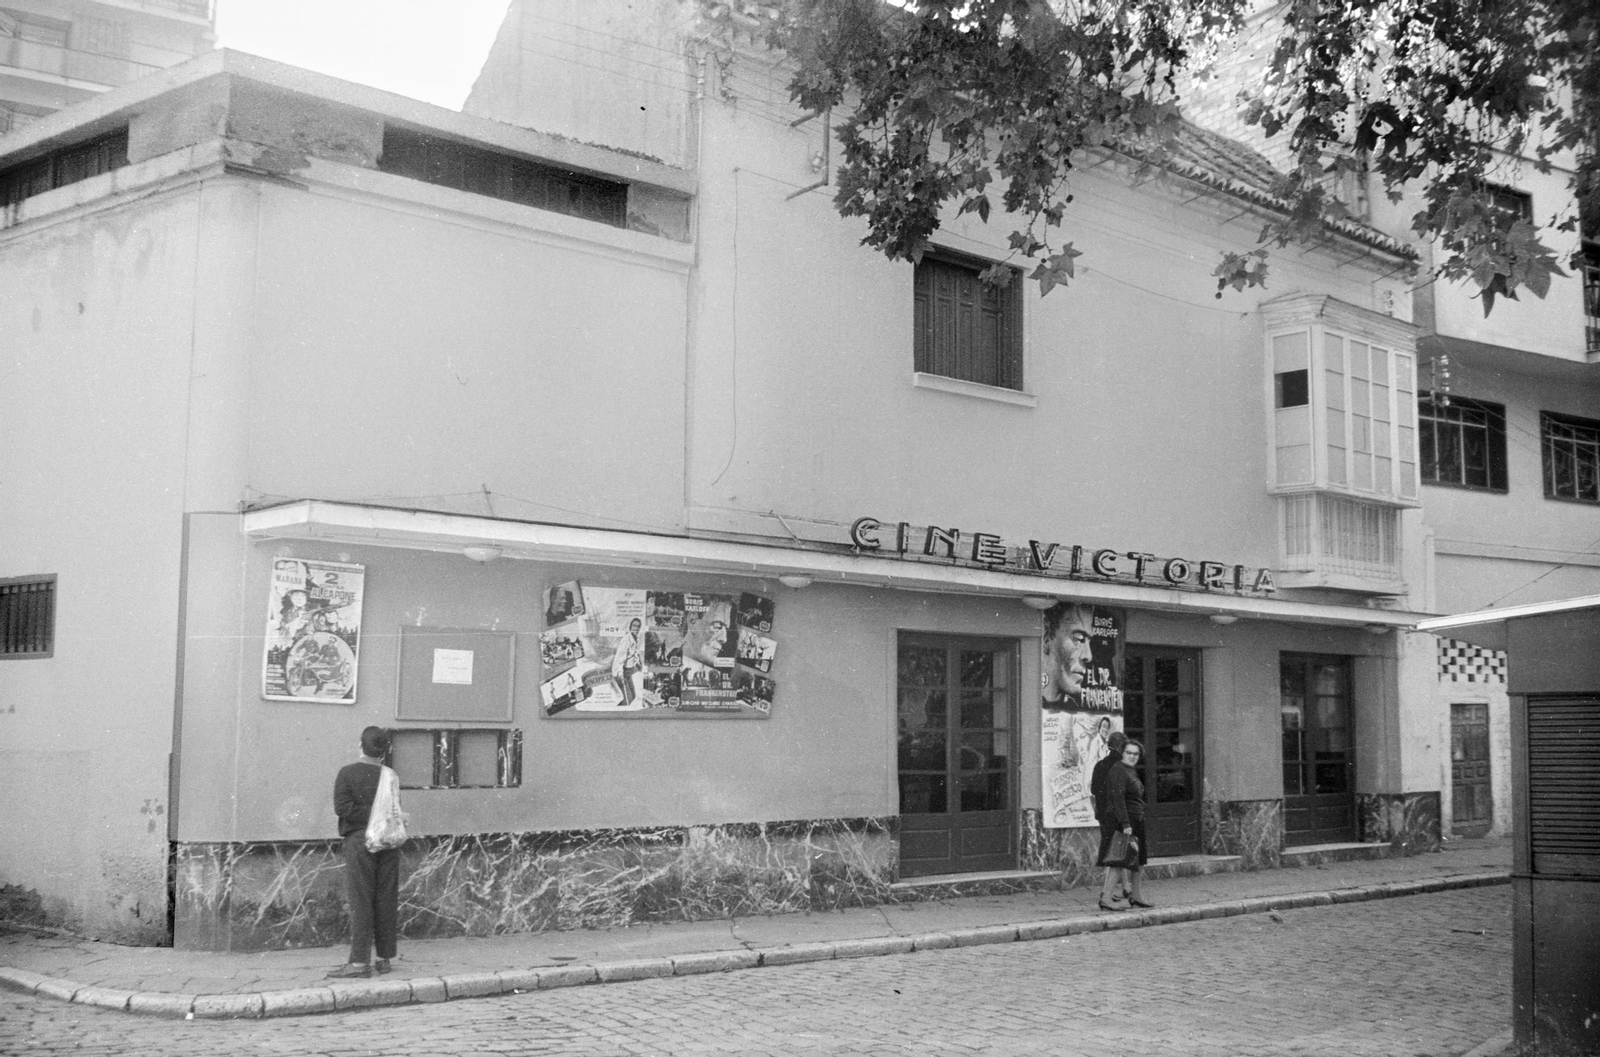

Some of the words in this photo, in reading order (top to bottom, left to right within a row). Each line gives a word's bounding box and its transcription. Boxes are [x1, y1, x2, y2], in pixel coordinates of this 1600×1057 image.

[850, 516, 1007, 564] CINE
[1028, 539, 1279, 594] VICTORIA
[325, 572, 339, 585] 2
[685, 598, 704, 606] BORIS
[685, 605, 711, 613] KARLOFF
[1094, 616, 1113, 629] BORIS
[1092, 627, 1119, 638] KARLOFF
[722, 672, 731, 681] EL
[1087, 664, 1099, 686] EL
[1098, 667, 1112, 686] DR.
[1080, 685, 1124, 712] FRANKENSTEIN
